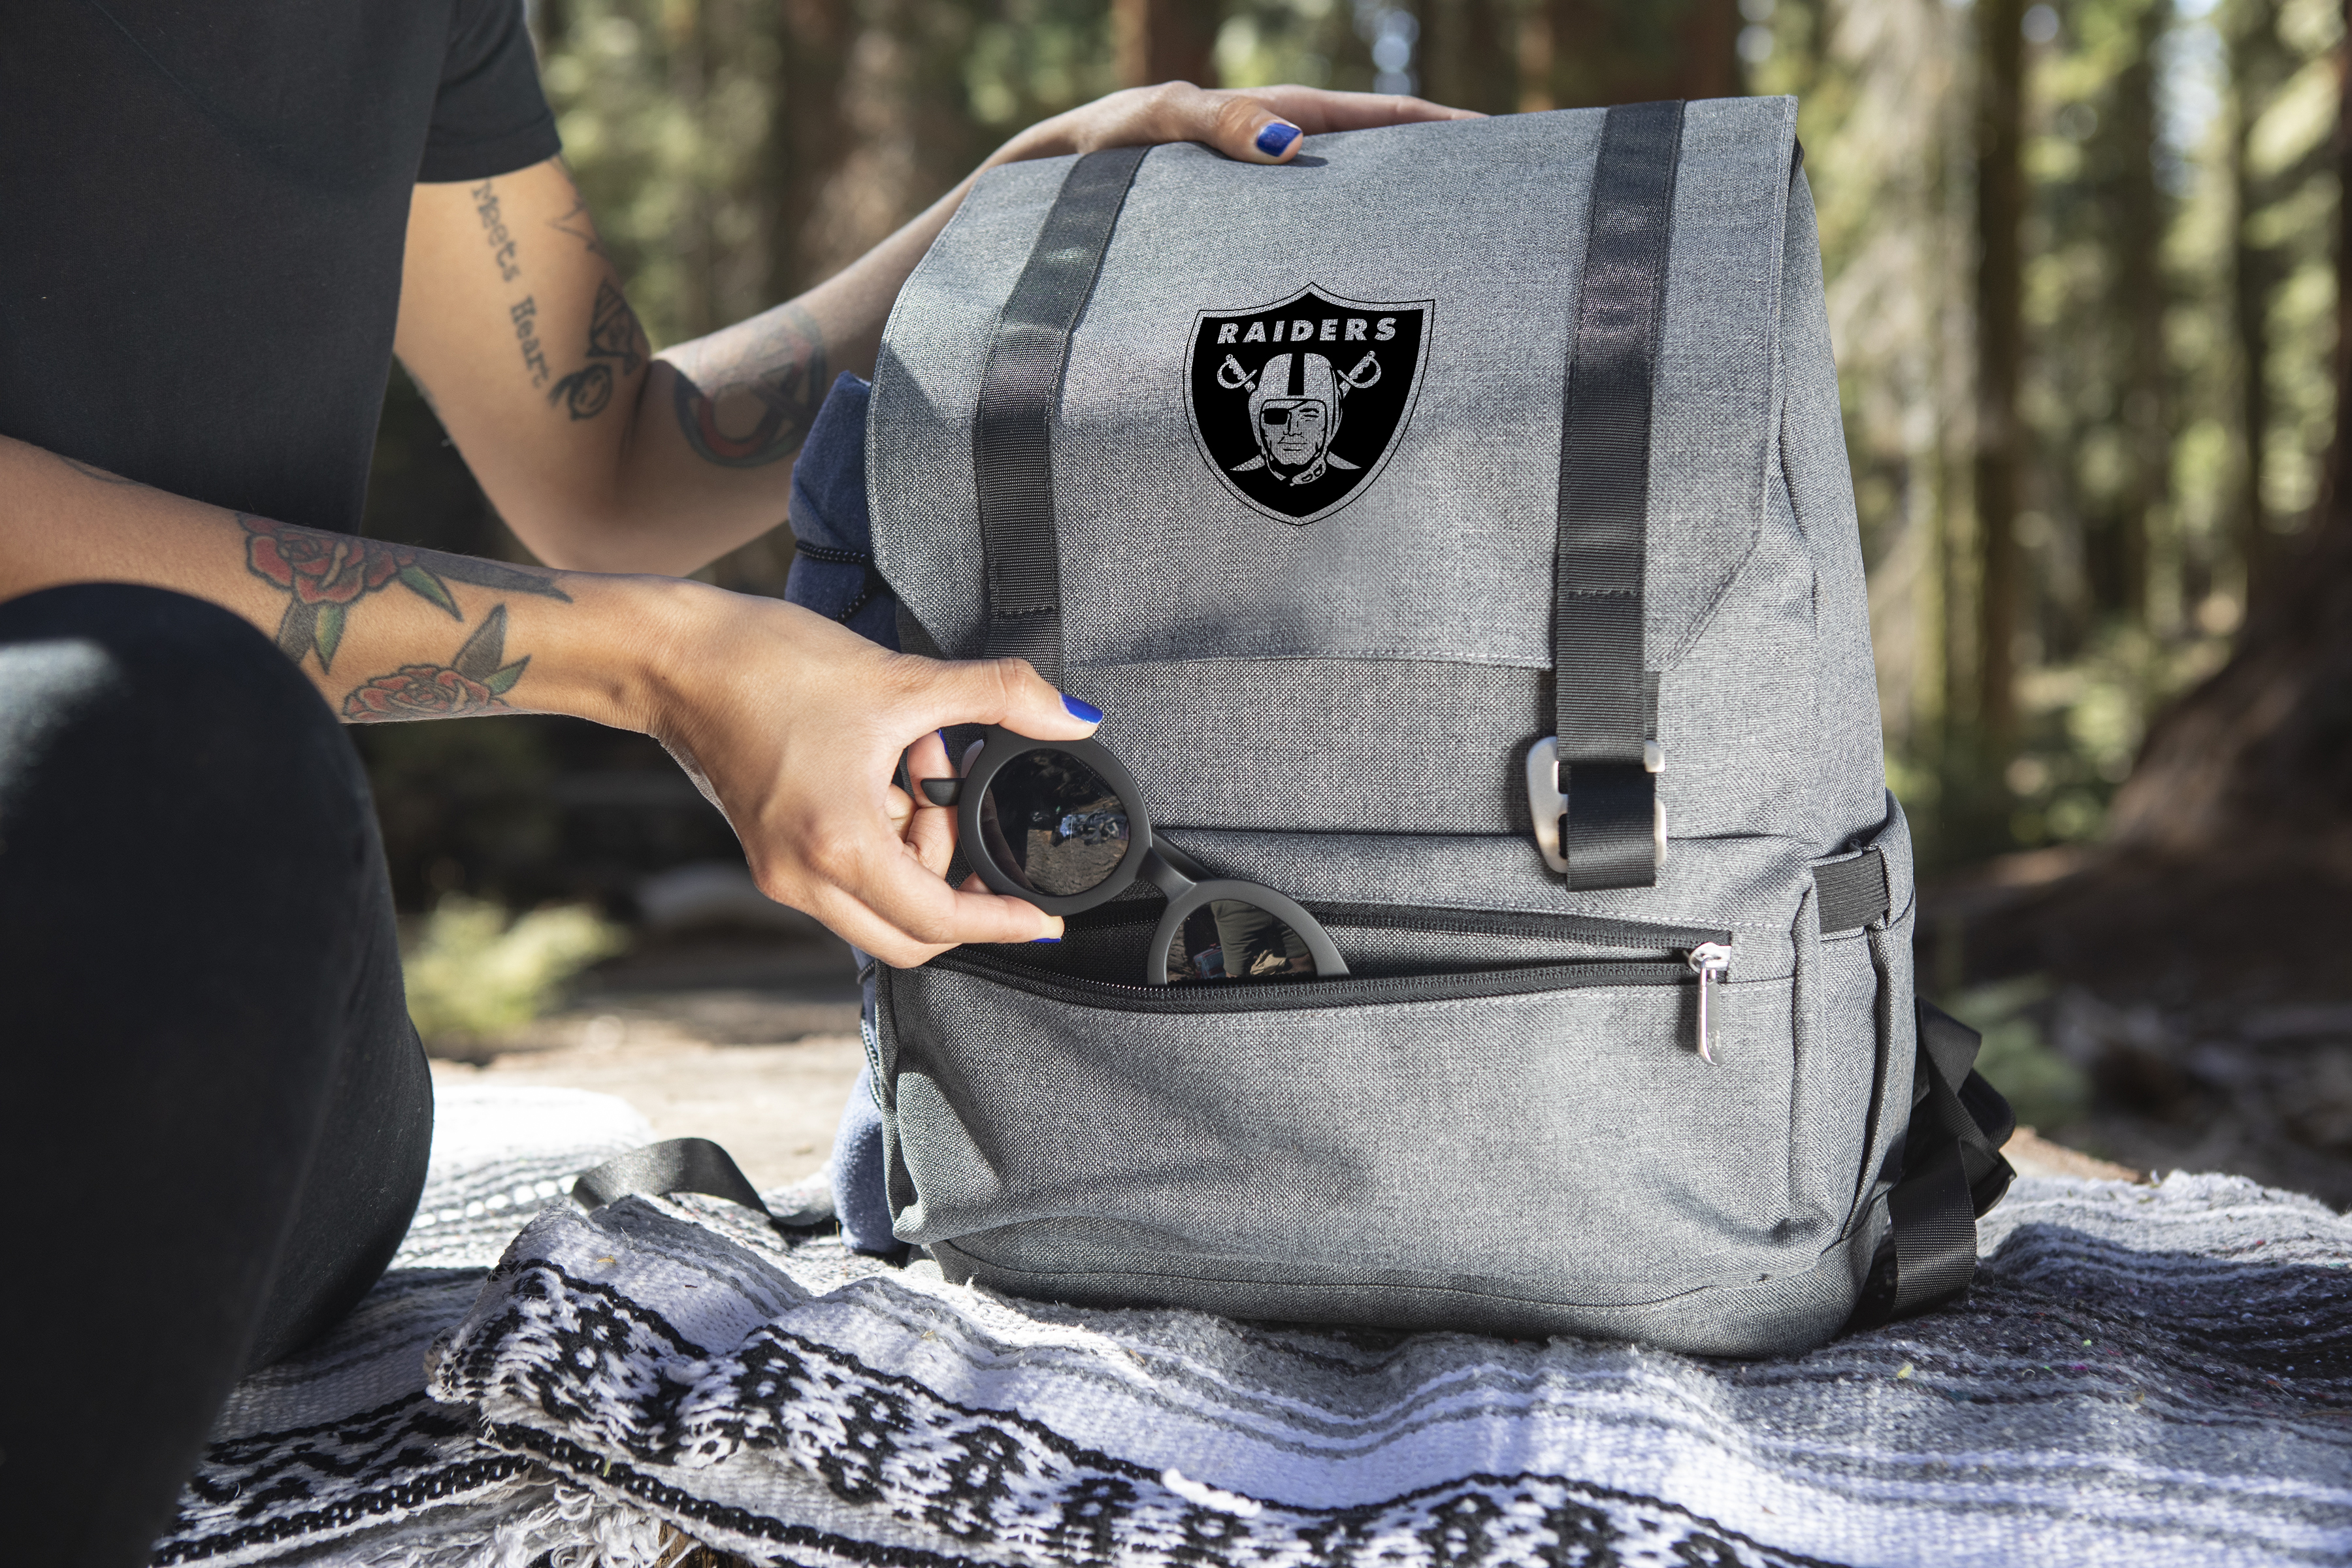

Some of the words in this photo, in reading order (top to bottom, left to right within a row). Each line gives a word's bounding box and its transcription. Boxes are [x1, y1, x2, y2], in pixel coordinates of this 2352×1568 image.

[472, 180, 521, 282] Meets
[511, 295, 551, 388] Heart
[1217, 318, 1397, 344] RAIDERS
